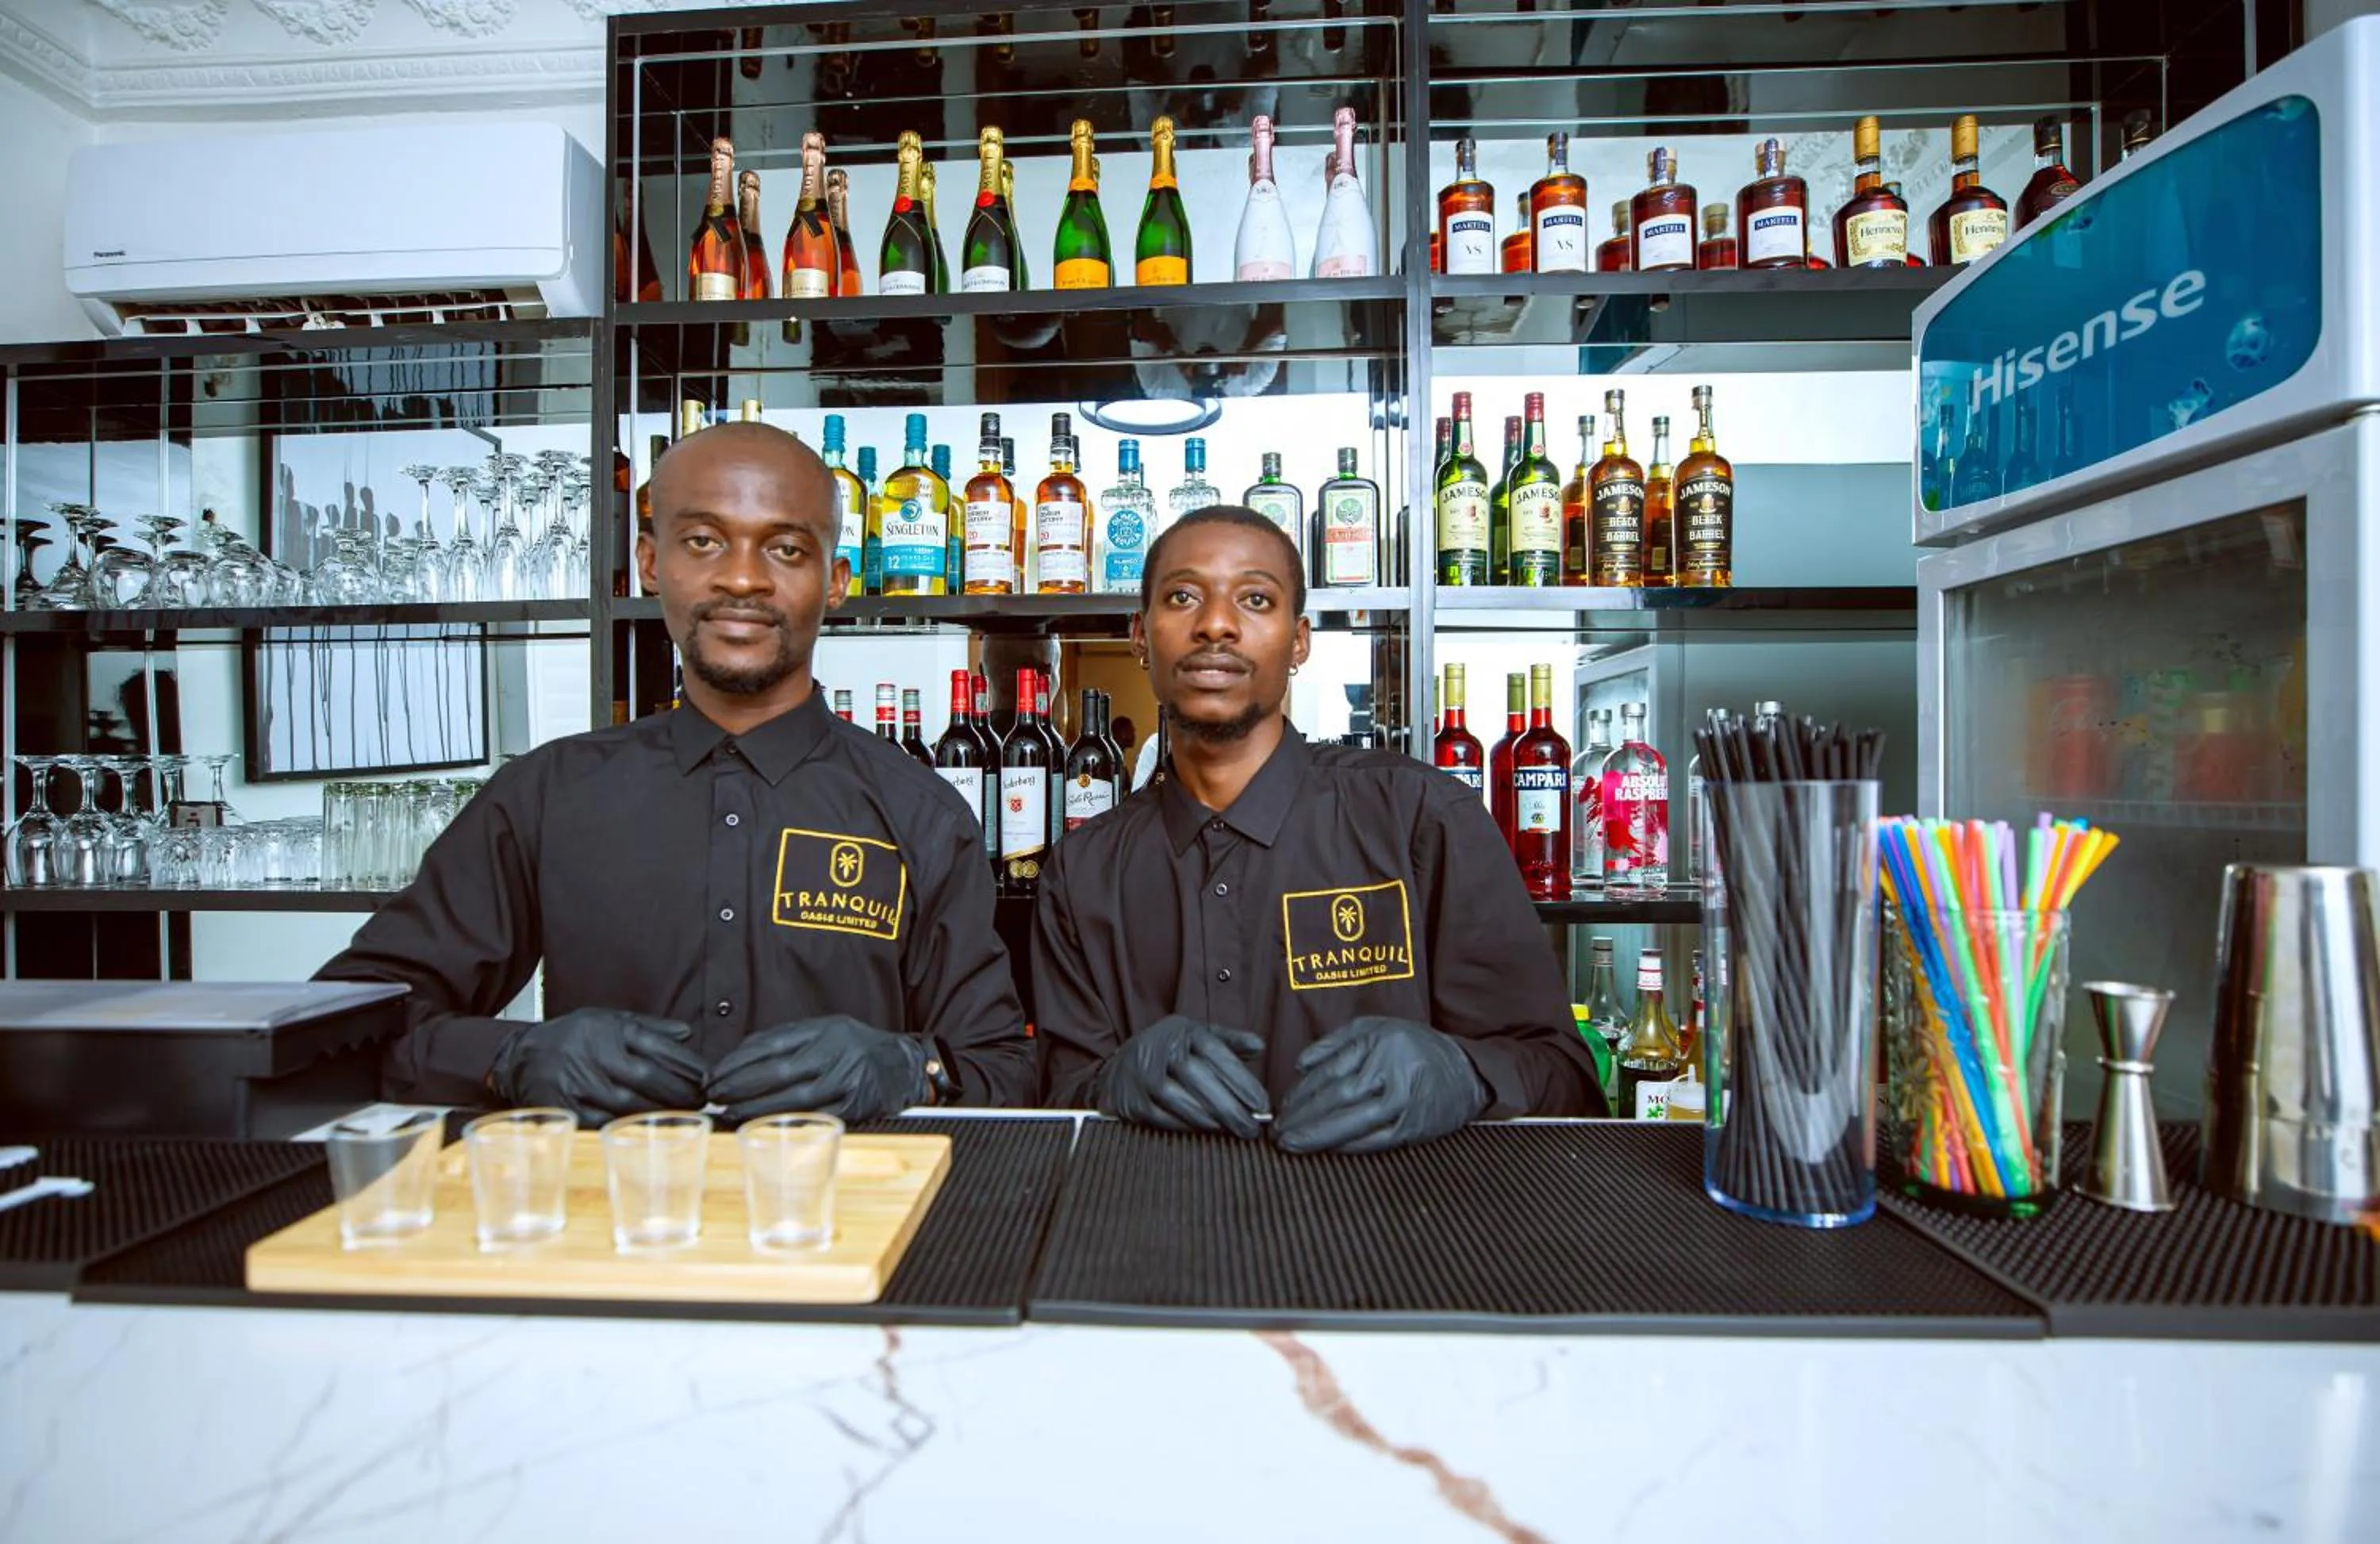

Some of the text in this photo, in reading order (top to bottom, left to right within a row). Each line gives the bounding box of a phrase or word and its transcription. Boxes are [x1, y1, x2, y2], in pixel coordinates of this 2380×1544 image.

[1972, 269, 2205, 415] Hisense
[1679, 482, 1731, 500] JAMESON
[886, 523, 939, 536] SINGLETON
[1689, 529, 1726, 540] BARREL
[889, 555, 900, 569] 12
[1514, 773, 1567, 787] CAMPARI
[780, 891, 896, 926] TRANQUIL
[800, 911, 877, 929] OASIS LIMITED
[1292, 946, 1408, 972] TRANQUIL
[1316, 964, 1387, 981] OASIS LIMITED
